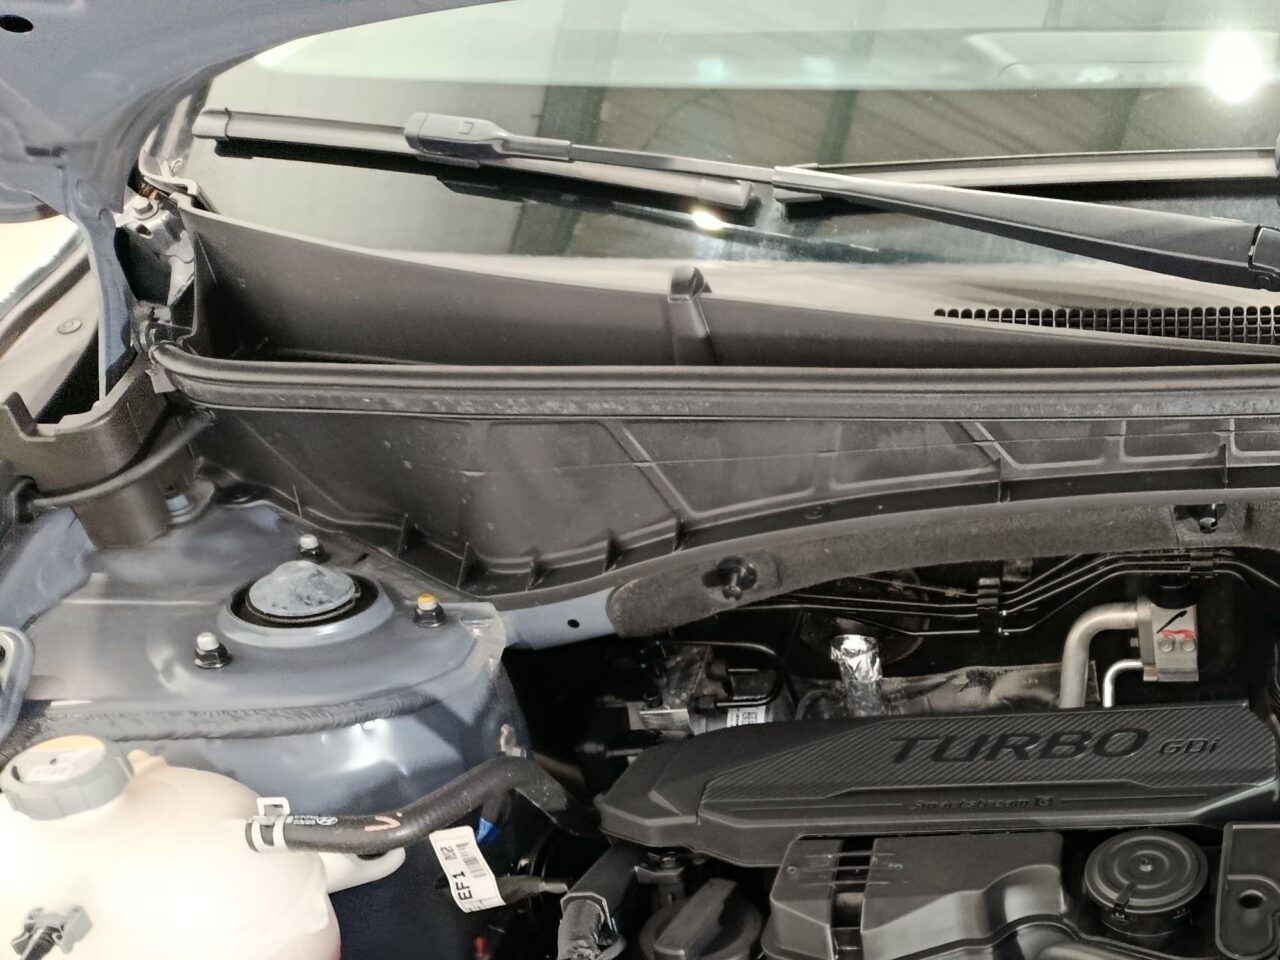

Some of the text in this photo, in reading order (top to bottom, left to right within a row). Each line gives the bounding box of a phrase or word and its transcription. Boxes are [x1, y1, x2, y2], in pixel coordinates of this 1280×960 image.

[889, 727, 1219, 764] TURBO GDi
[452, 871, 473, 900] EF1
